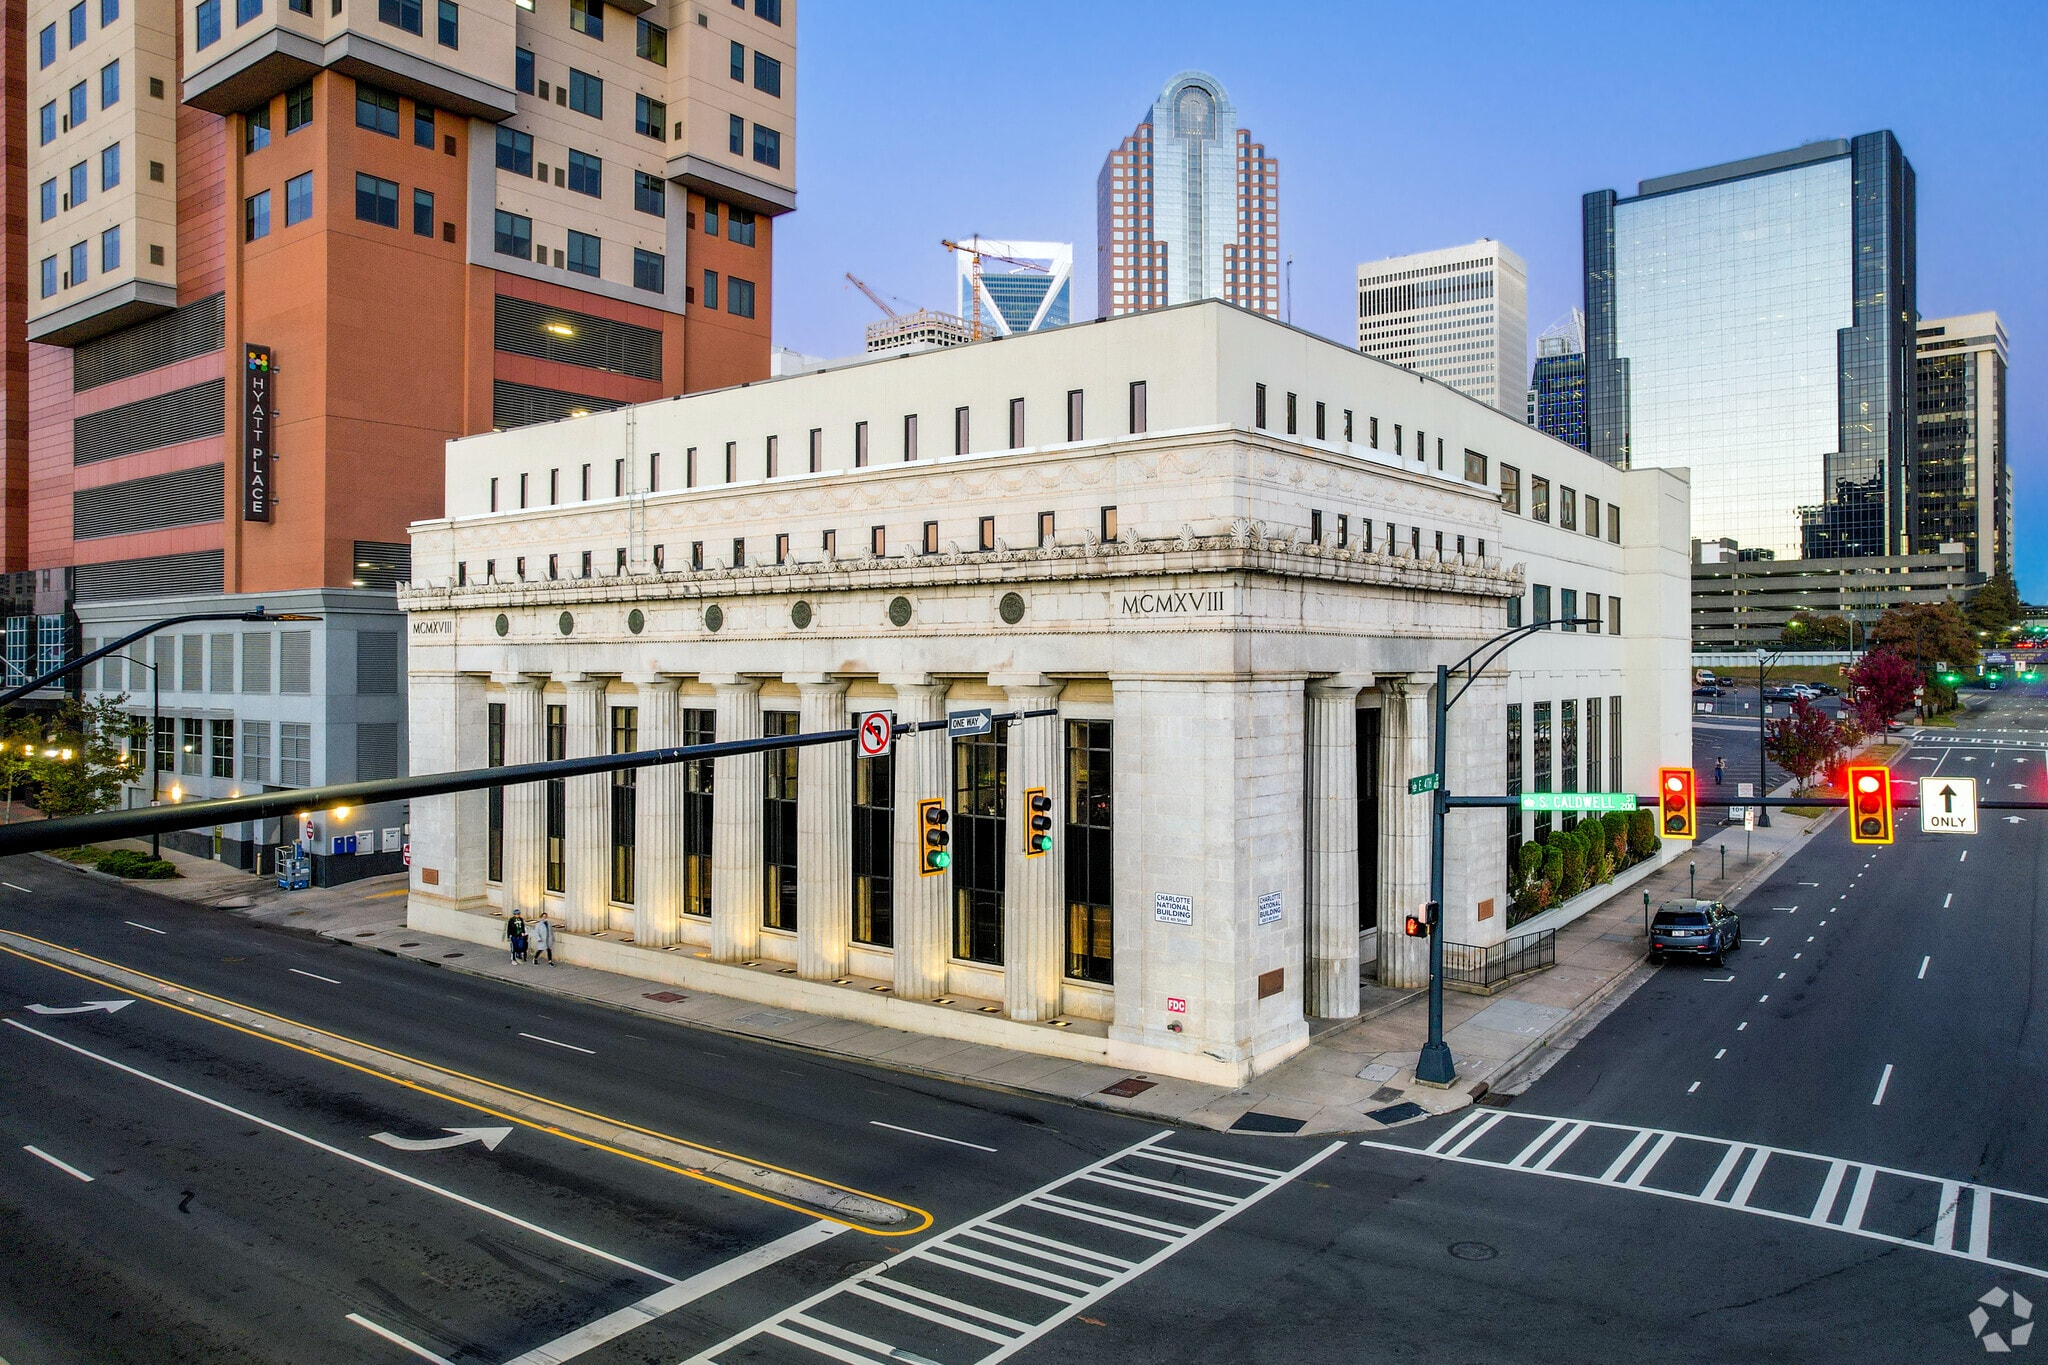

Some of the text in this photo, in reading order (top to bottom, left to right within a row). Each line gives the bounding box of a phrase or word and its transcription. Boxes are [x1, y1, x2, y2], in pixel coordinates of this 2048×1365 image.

[252, 377, 265, 513] HYATT PLACE
[1122, 591, 1224, 614] MCMXVIII
[412, 621, 452, 634] MCMXVIII
[952, 717, 979, 728] ONE WAY
[1553, 796, 1616, 809] CALDWELL
[1625, 794, 1635, 803] ST
[1620, 802, 1635, 811] 200
[1931, 816, 1967, 828] ONLY
[1157, 894, 1191, 904] CHARLOTTE
[1260, 893, 1281, 904] CHARLOTTE
[1157, 902, 1191, 911] NATIONAL
[1260, 901, 1281, 910] NATIONAL
[1157, 909, 1191, 918] BUILDING
[1260, 907, 1281, 918] BUILDING
[1168, 999, 1185, 1011] FDC
